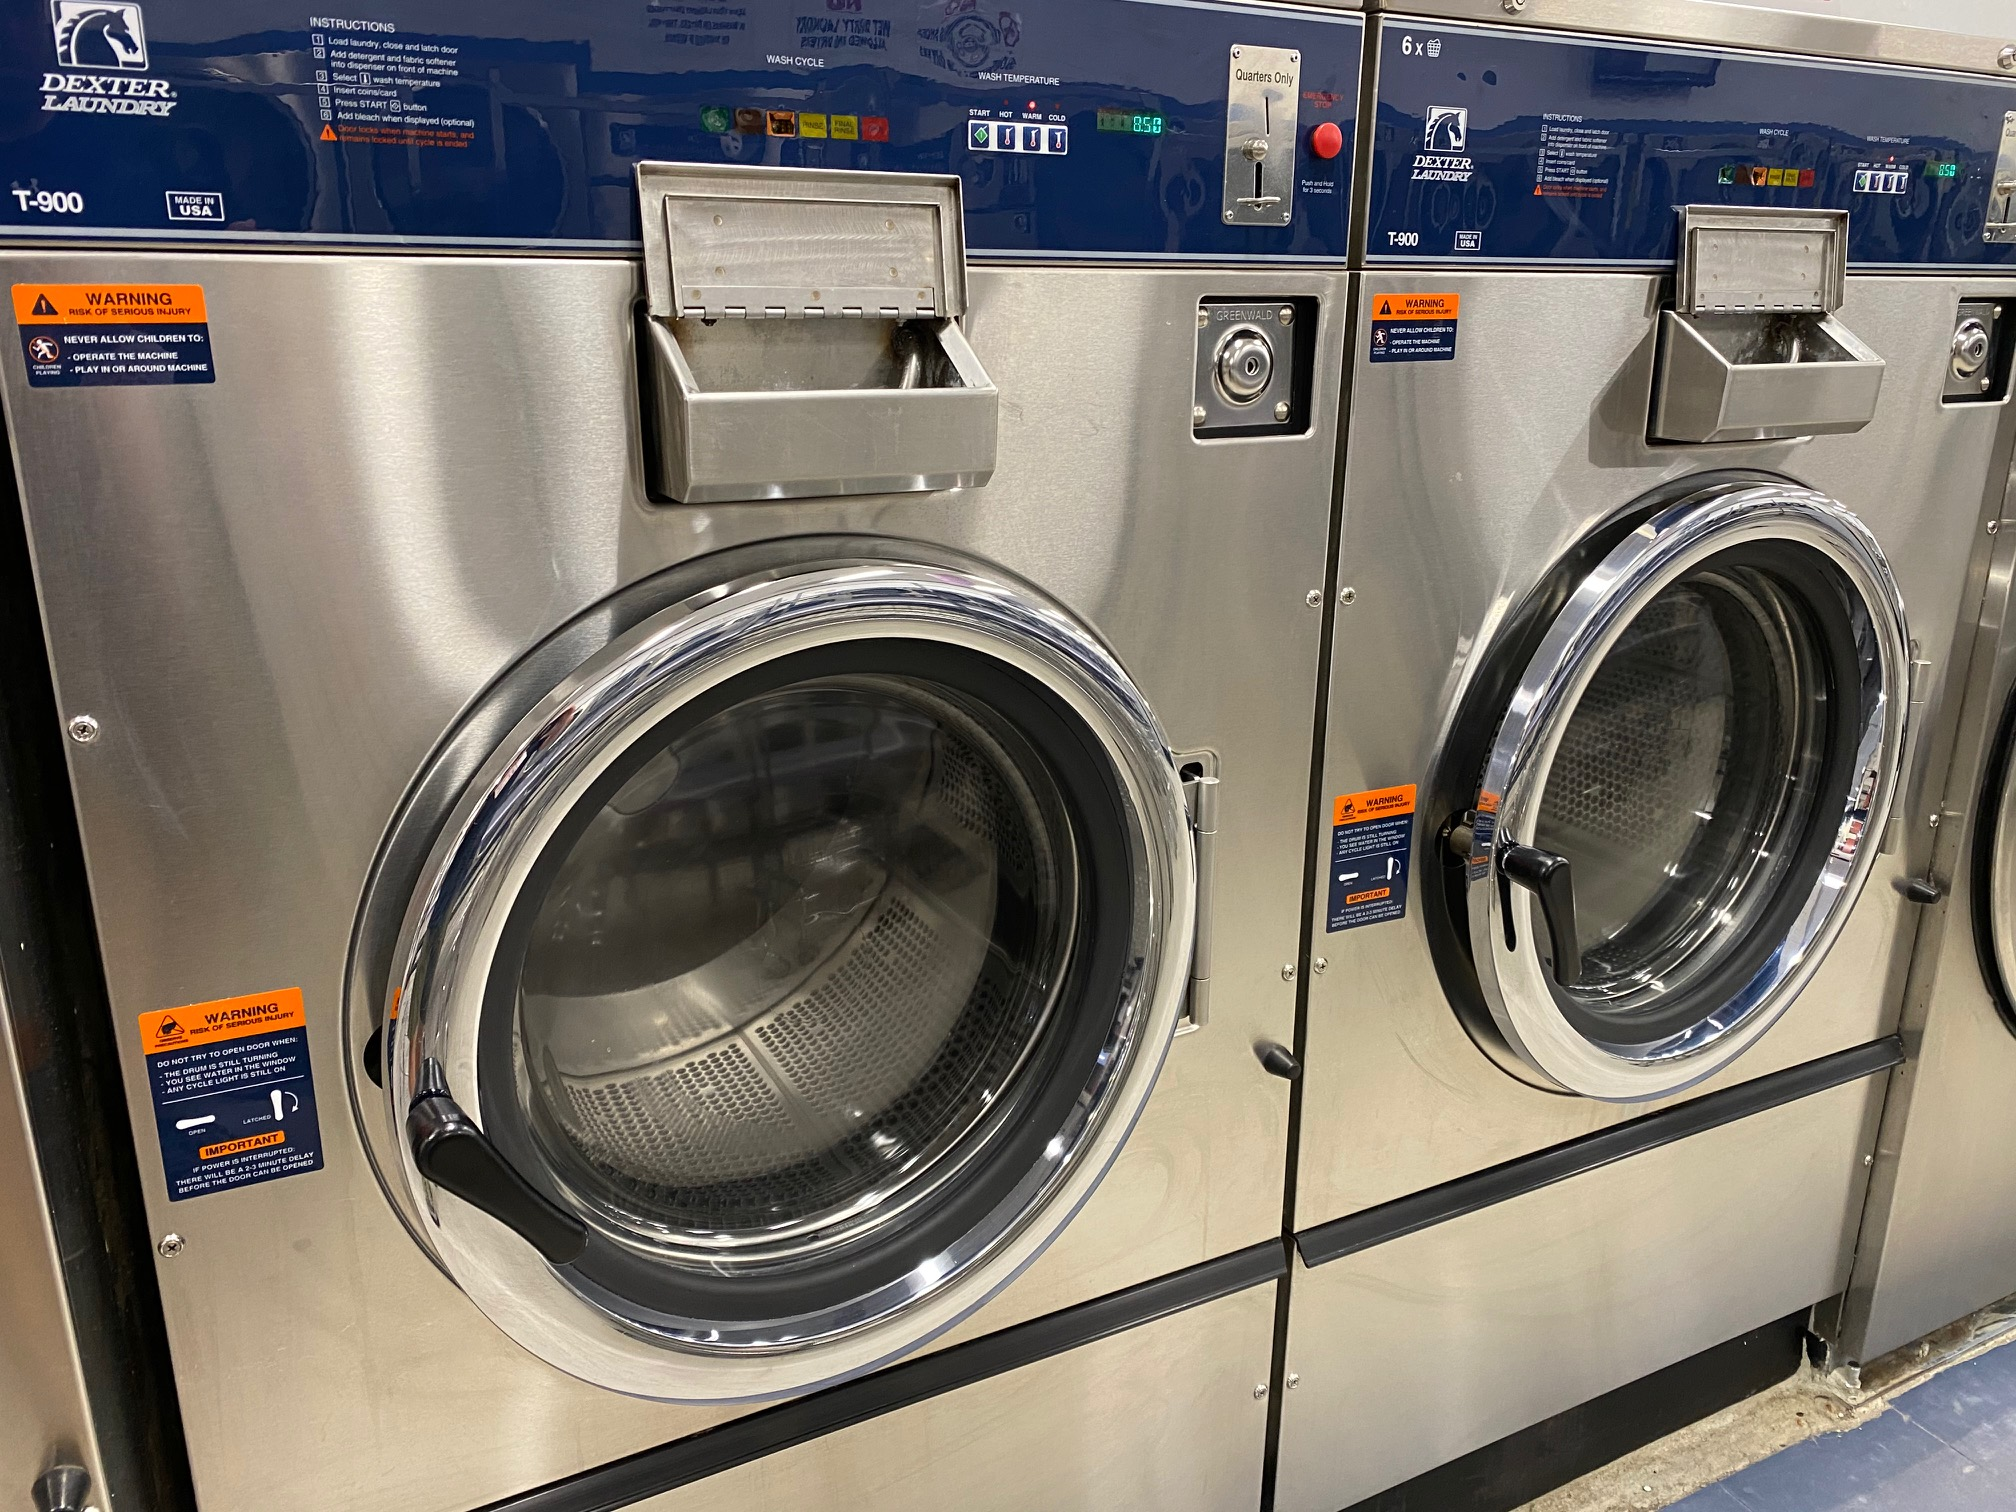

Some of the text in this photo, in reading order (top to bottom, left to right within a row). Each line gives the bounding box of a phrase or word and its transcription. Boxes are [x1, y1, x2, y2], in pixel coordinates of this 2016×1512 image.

[310, 17, 395, 33] INSTRUCTIONS
[329, 37, 348, 45] Load
[350, 39, 381, 49] laundry,
[383, 41, 403, 49] close
[421, 44, 439, 52] latch
[1402, 36, 1423, 56] 6 x
[331, 50, 346, 58] Add
[348, 52, 385, 62] detergent
[403, 56, 424, 64] fabric
[426, 58, 456, 66] softener
[766, 55, 824, 67] WASH CYCLE
[331, 60, 345, 68] into
[347, 61, 385, 71] dispenser
[398, 65, 415, 73] front
[427, 68, 458, 76] machine
[333, 73, 357, 81] Select
[395, 78, 440, 87] temperature
[978, 72, 1059, 85] WASH TEMPERATURE
[1236, 69, 1294, 87] Quarters Only
[334, 86, 355, 94] Insert
[41, 95, 177, 116] LAUNDRY
[335, 99, 427, 111] Press START button
[969, 109, 990, 117] START
[999, 111, 1012, 119] HOT
[1049, 114, 1065, 122] COLD
[1543, 114, 1582, 122] INSTRUCTIONS
[355, 113, 379, 121] bleach
[382, 115, 402, 123] when
[404, 116, 439, 125] displayed
[441, 118, 474, 128] (optional)
[1413, 155, 1471, 169] DEXTER
[1411, 170, 1473, 181] LAUNDRY
[12, 190, 83, 213] T-900
[175, 196, 202, 204] MADE
[180, 205, 212, 216] USA
[1388, 232, 1419, 246] T-900
[86, 293, 172, 305] WARNING
[1406, 299, 1444, 307] WARNING
[1216, 310, 1273, 321] GREENWALD
[64, 336, 97, 344] NEVER
[100, 335, 136, 343] ALLOW
[137, 335, 185, 343] CHILDREN
[73, 353, 116, 361] OPERATE
[137, 352, 178, 360] MACHINE
[168, 364, 207, 372] MACHINE
[1366, 795, 1403, 807] WARNING
[1349, 890, 1386, 901] IMPORTANT
[205, 1003, 278, 1024] WARNING
[190, 1012, 294, 1035] RISK OF SERIOUS INJURY
[157, 1060, 169, 1068] DO
[172, 1057, 188, 1066] NOT
[191, 1054, 207, 1062] TRY
[222, 1047, 245, 1056] OPEN
[246, 1042, 270, 1051] DOOR
[272, 1037, 298, 1046] WHEN:
[183, 1066, 207, 1074] DRUM
[219, 1059, 240, 1068] STILL
[242, 1052, 278, 1064] TURNING
[166, 1078, 183, 1086] YOU
[204, 1069, 231, 1079] WATER
[262, 1056, 296, 1067] WINDOW
[167, 1086, 184, 1094] ANY
[186, 1080, 213, 1090] CYCLE
[215, 1075, 238, 1085] LIGHT
[250, 1069, 272, 1078] STILL
[243, 1115, 271, 1124] LATCHED
[205, 1134, 278, 1156] IMPORTANT
[202, 1161, 230, 1171] POWER
[241, 1147, 295, 1162] INTERRUPTED:
[176, 1176, 202, 1186] THERE
[204, 1172, 223, 1181] WILL
[258, 1158, 287, 1168] MINUTE
[289, 1152, 314, 1161] DELAY
[179, 1183, 210, 1194] BEFORE
[229, 1173, 251, 1182] DOOR
[253, 1169, 269, 1177] CAN
[283, 1160, 314, 1170] OPENED
